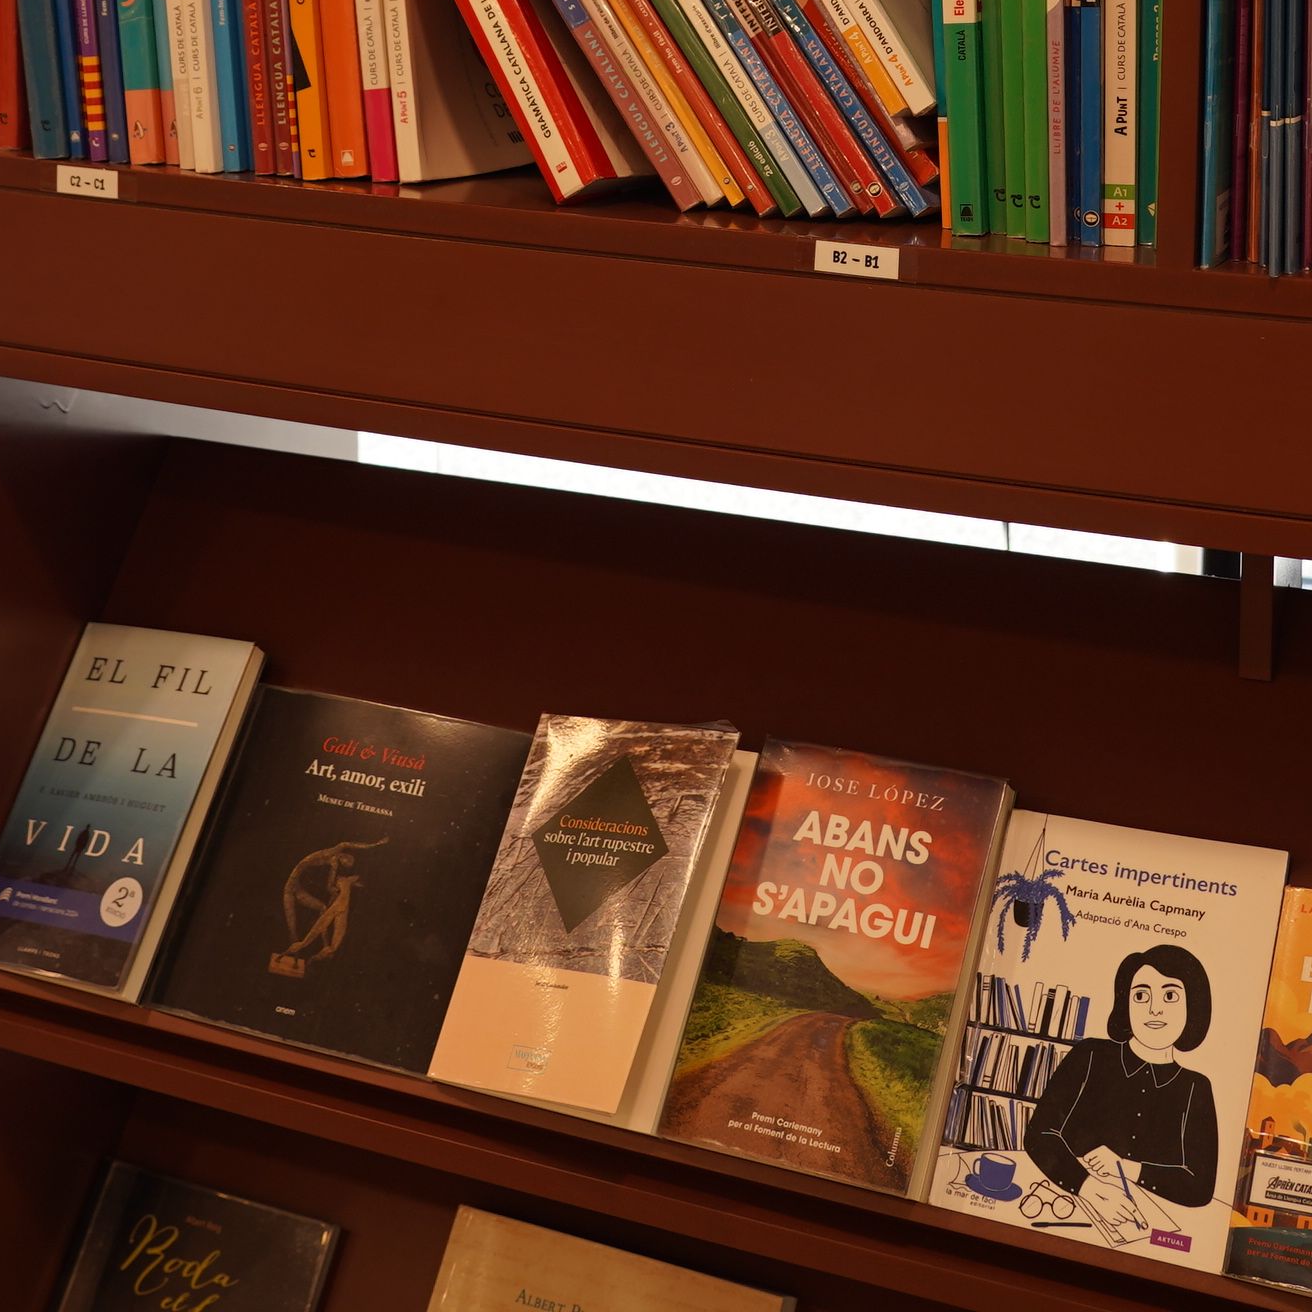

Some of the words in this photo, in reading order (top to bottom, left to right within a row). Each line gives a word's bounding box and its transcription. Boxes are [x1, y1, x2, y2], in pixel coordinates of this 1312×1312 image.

[493, 19, 522, 75] CATALANA
[518, 76, 552, 139] GRAMÀTICA
[70, 175, 82, 187] C2
[94, 178, 105, 191] C1
[832, 250, 846, 265] B2
[865, 253, 879, 268] B1
[86, 657, 129, 684] EL
[151, 664, 213, 696] FIL
[131, 748, 179, 779] LA
[381, 747, 425, 771] Viusà
[306, 759, 336, 781] Art,
[340, 769, 386, 791] amor,
[389, 776, 425, 797] exili
[806, 772, 859, 796] JOSE
[869, 778, 946, 811] LÓPEZ
[25, 820, 145, 866] VIDA
[544, 830, 578, 847] sobre
[580, 833, 601, 850] l'art
[603, 837, 655, 855] rupestre
[560, 814, 649, 837] Consideracions
[793, 810, 933, 866] ABANS
[573, 850, 619, 868] popular
[819, 852, 885, 895] NO
[1045, 849, 1109, 877] Cartes
[1114, 859, 1238, 898] impertinents
[752, 881, 937, 950] S'APAGUI
[1066, 885, 1098, 901] Maria
[1101, 891, 1146, 910] Aurèlia
[1149, 898, 1206, 922] Capmany
[1075, 910, 1119, 928] Adaptació
[1152, 922, 1187, 940] Crespo
[751, 1111, 774, 1124] Premi
[776, 1116, 823, 1137] Carlemany
[754, 1124, 784, 1139] Foment
[786, 1131, 797, 1142] de
[809, 1136, 840, 1153] Lectura
[885, 1126, 902, 1168] Columna
[1157, 1236, 1185, 1248] AKTUAL
